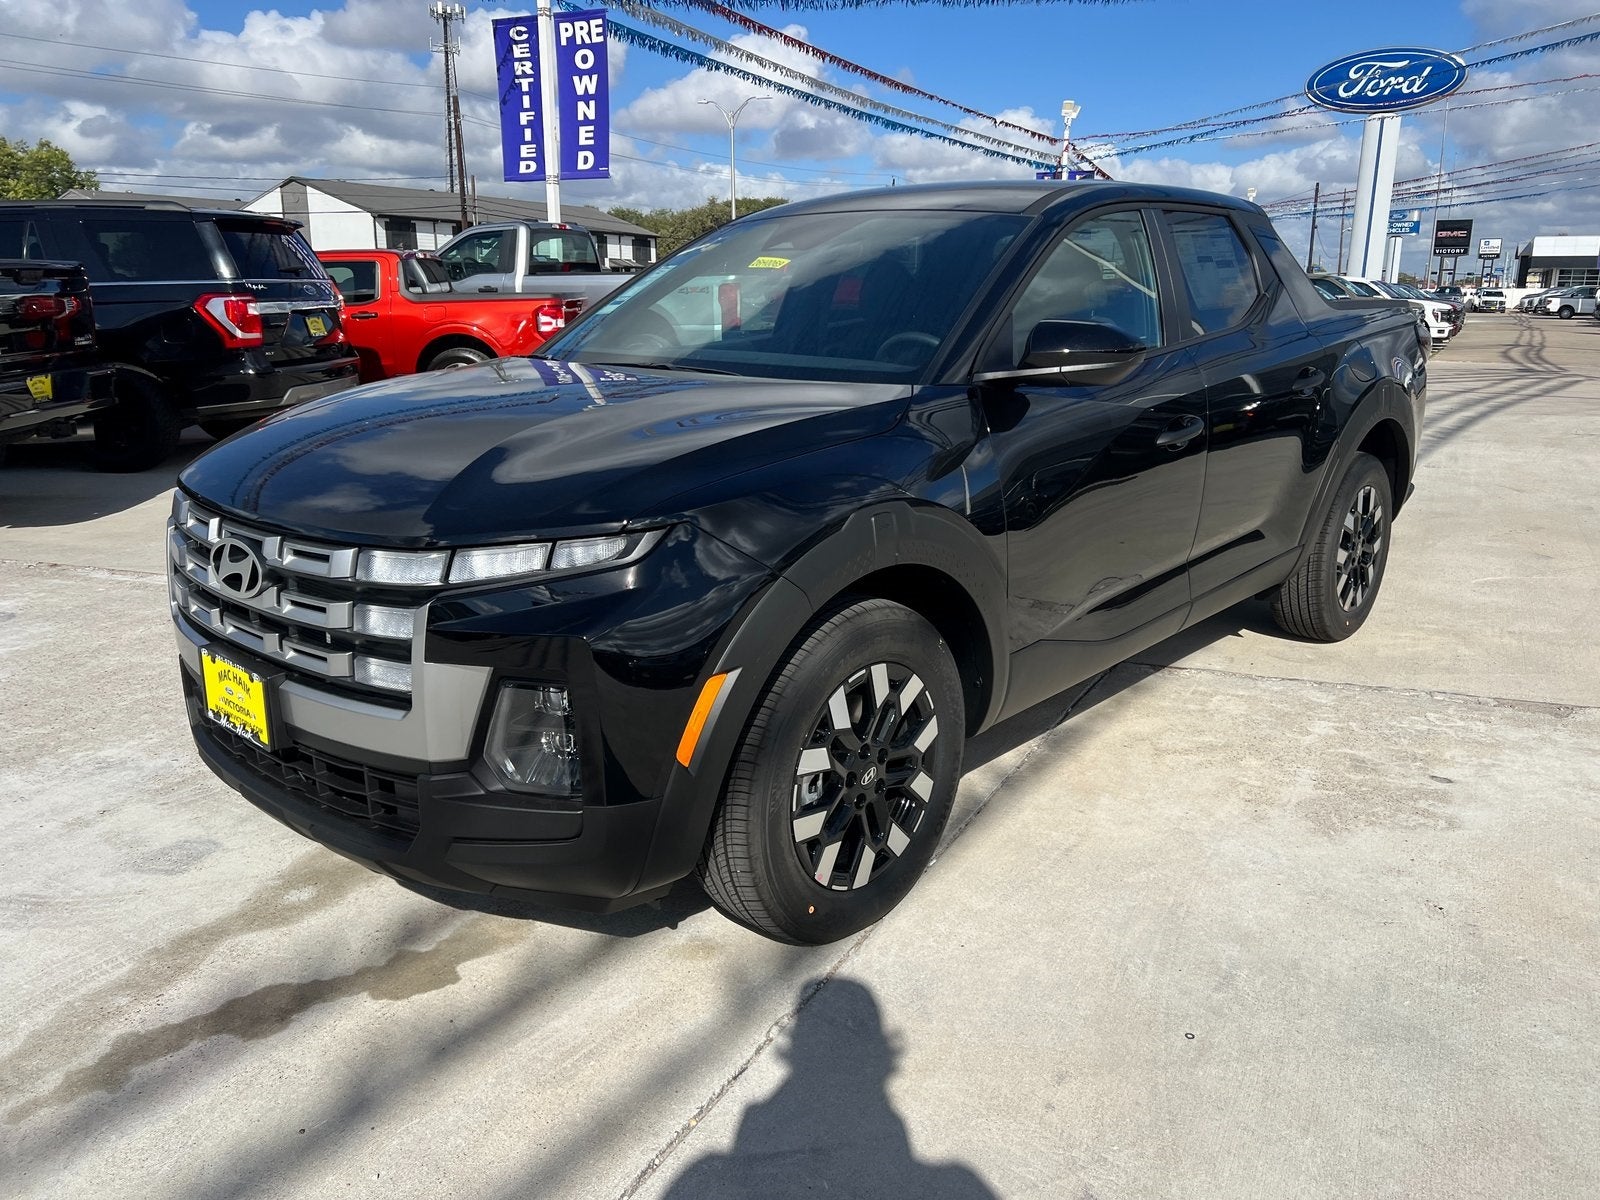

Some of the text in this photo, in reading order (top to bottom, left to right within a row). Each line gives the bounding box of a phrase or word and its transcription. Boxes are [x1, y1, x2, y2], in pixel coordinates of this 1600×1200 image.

[559, 18, 604, 46] PRE
[1338, 59, 1432, 98] Ford
[509, 26, 537, 174] CERTIFIED
[572, 49, 599, 171] OWNED
[218, 669, 231, 684] MAC
[232, 671, 252, 699] HAIK
[220, 713, 237, 732] Mac
[224, 698, 251, 717] VICTORIA
